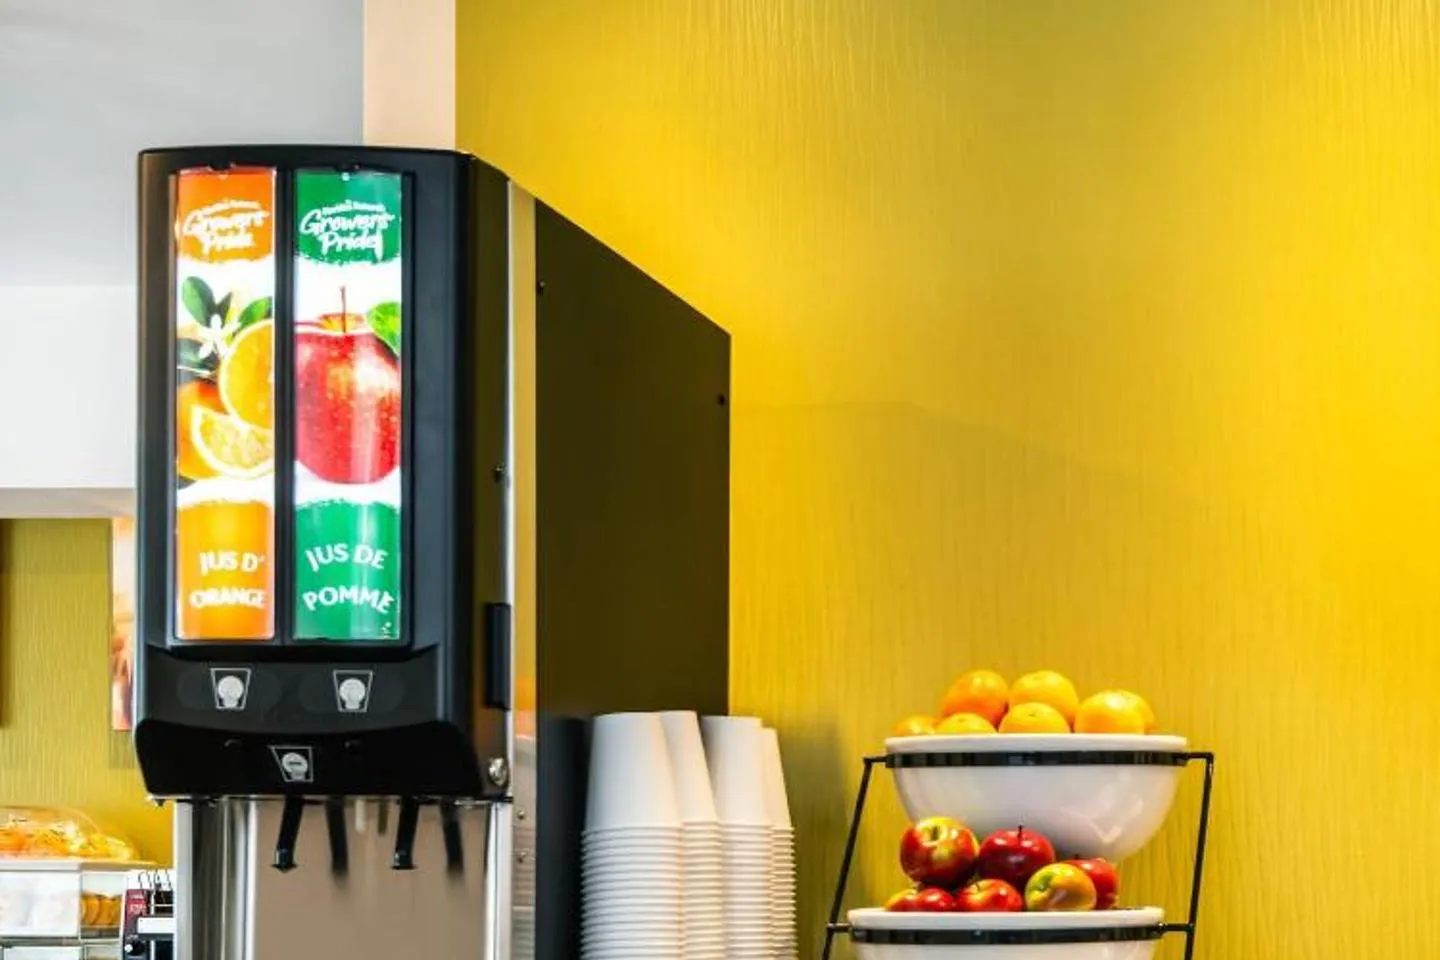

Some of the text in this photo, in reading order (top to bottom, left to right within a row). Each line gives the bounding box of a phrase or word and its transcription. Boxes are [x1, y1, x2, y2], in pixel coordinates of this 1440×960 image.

[300, 208, 396, 236] Growers
[199, 551, 238, 577] JUS
[305, 543, 389, 573] JUS DE
[188, 586, 266, 610] ORANGE
[302, 585, 395, 614] POMME
